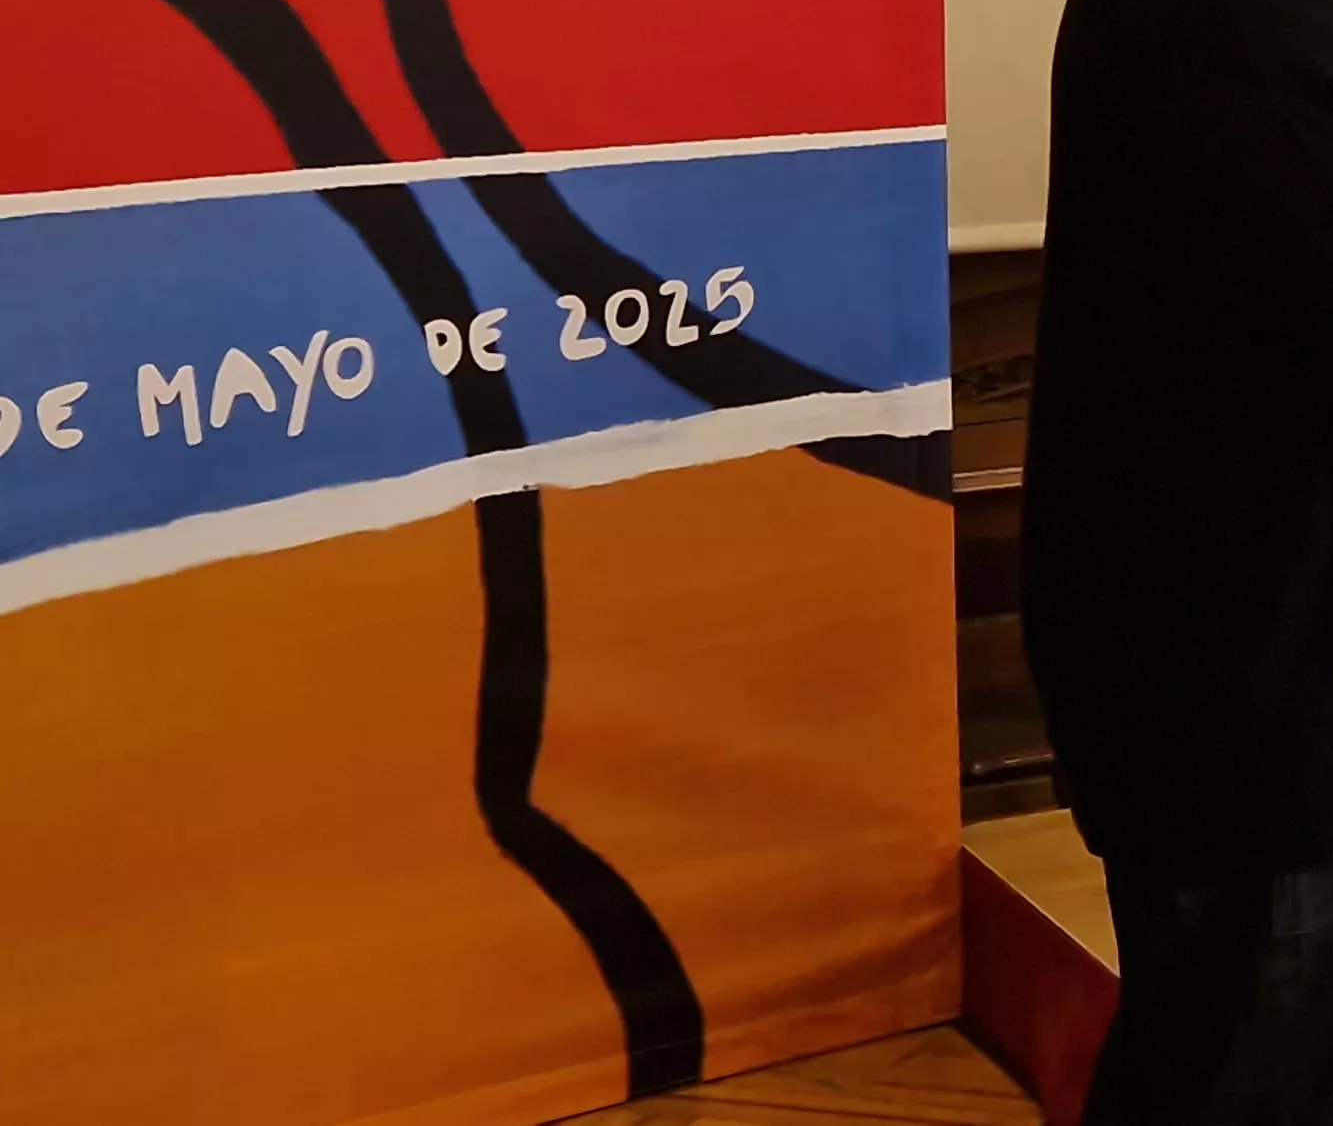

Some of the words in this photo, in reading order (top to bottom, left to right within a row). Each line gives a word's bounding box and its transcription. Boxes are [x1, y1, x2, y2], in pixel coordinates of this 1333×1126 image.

[137, 330, 375, 447] MAYO
[425, 307, 508, 376] DE
[557, 265, 755, 361] 2025
